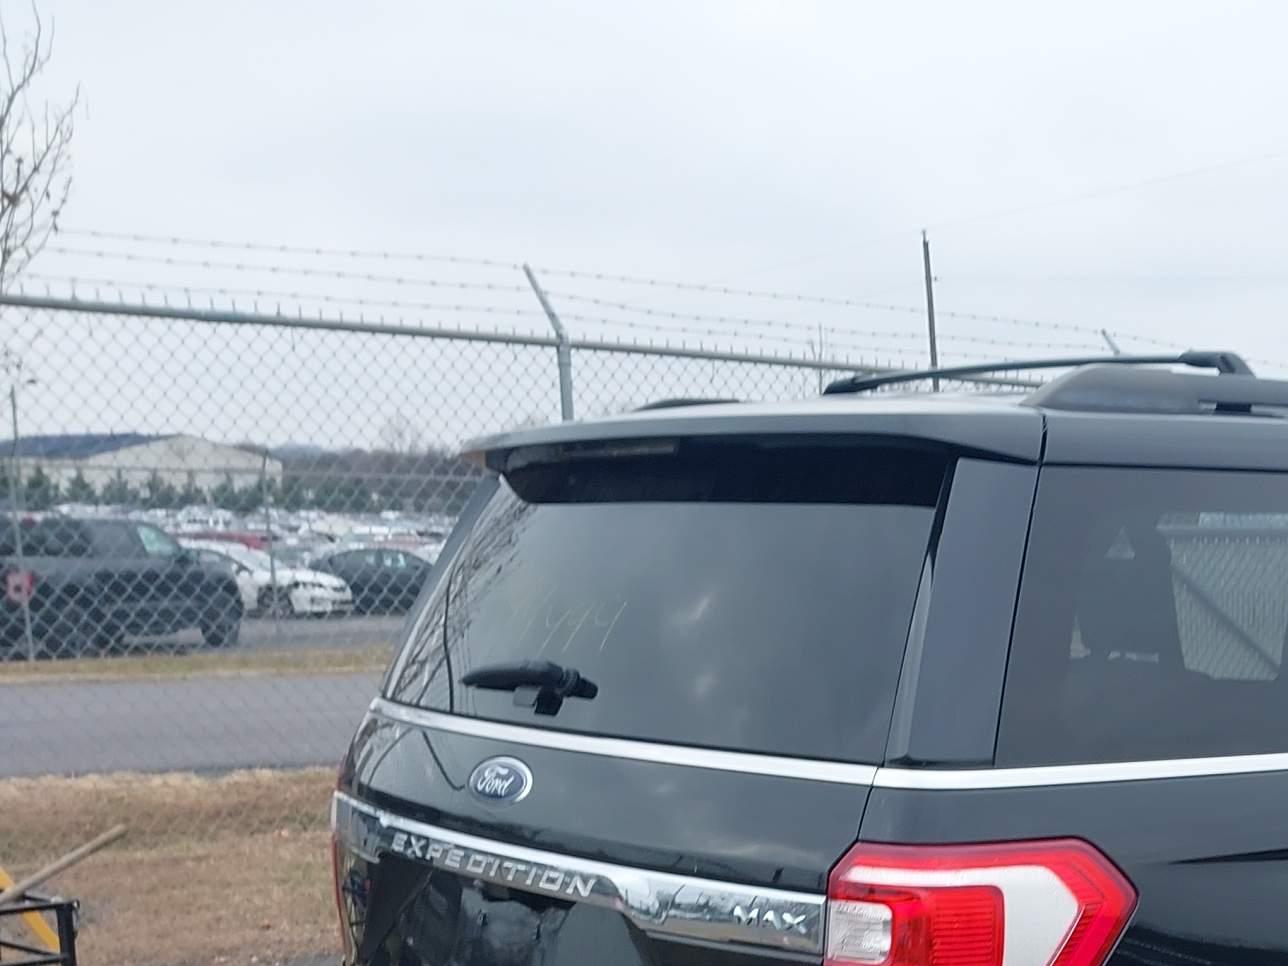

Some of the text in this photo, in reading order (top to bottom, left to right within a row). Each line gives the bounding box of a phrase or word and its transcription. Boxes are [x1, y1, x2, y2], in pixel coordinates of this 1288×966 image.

[477, 765, 515, 797] Ford
[391, 831, 807, 934] EXPEDITION MAX
